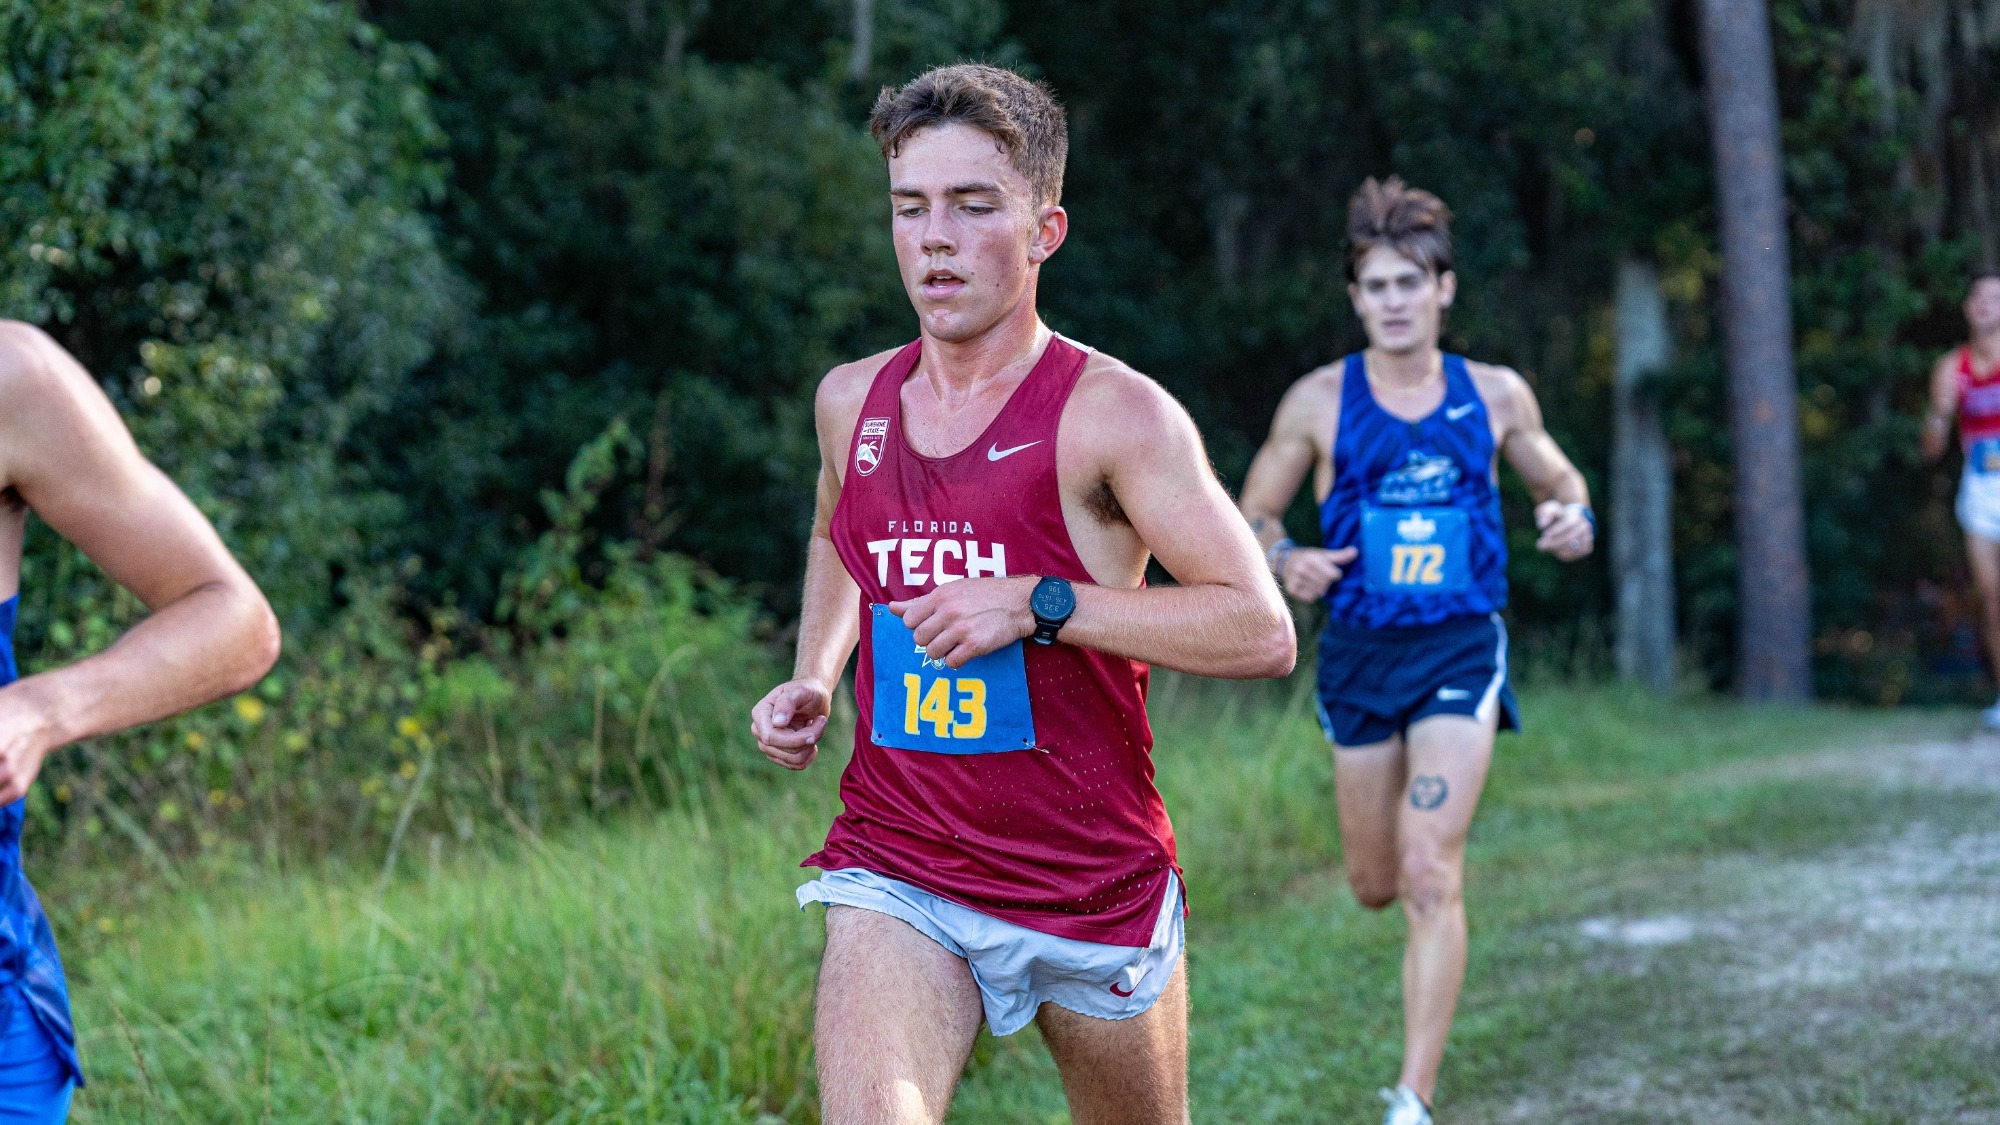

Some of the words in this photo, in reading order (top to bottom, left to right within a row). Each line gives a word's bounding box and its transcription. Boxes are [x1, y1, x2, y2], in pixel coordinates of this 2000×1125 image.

[888, 520, 974, 534] FLORIDA
[867, 538, 1006, 587] TECH
[1391, 544, 1446, 585] 172
[903, 672, 988, 739] 143
